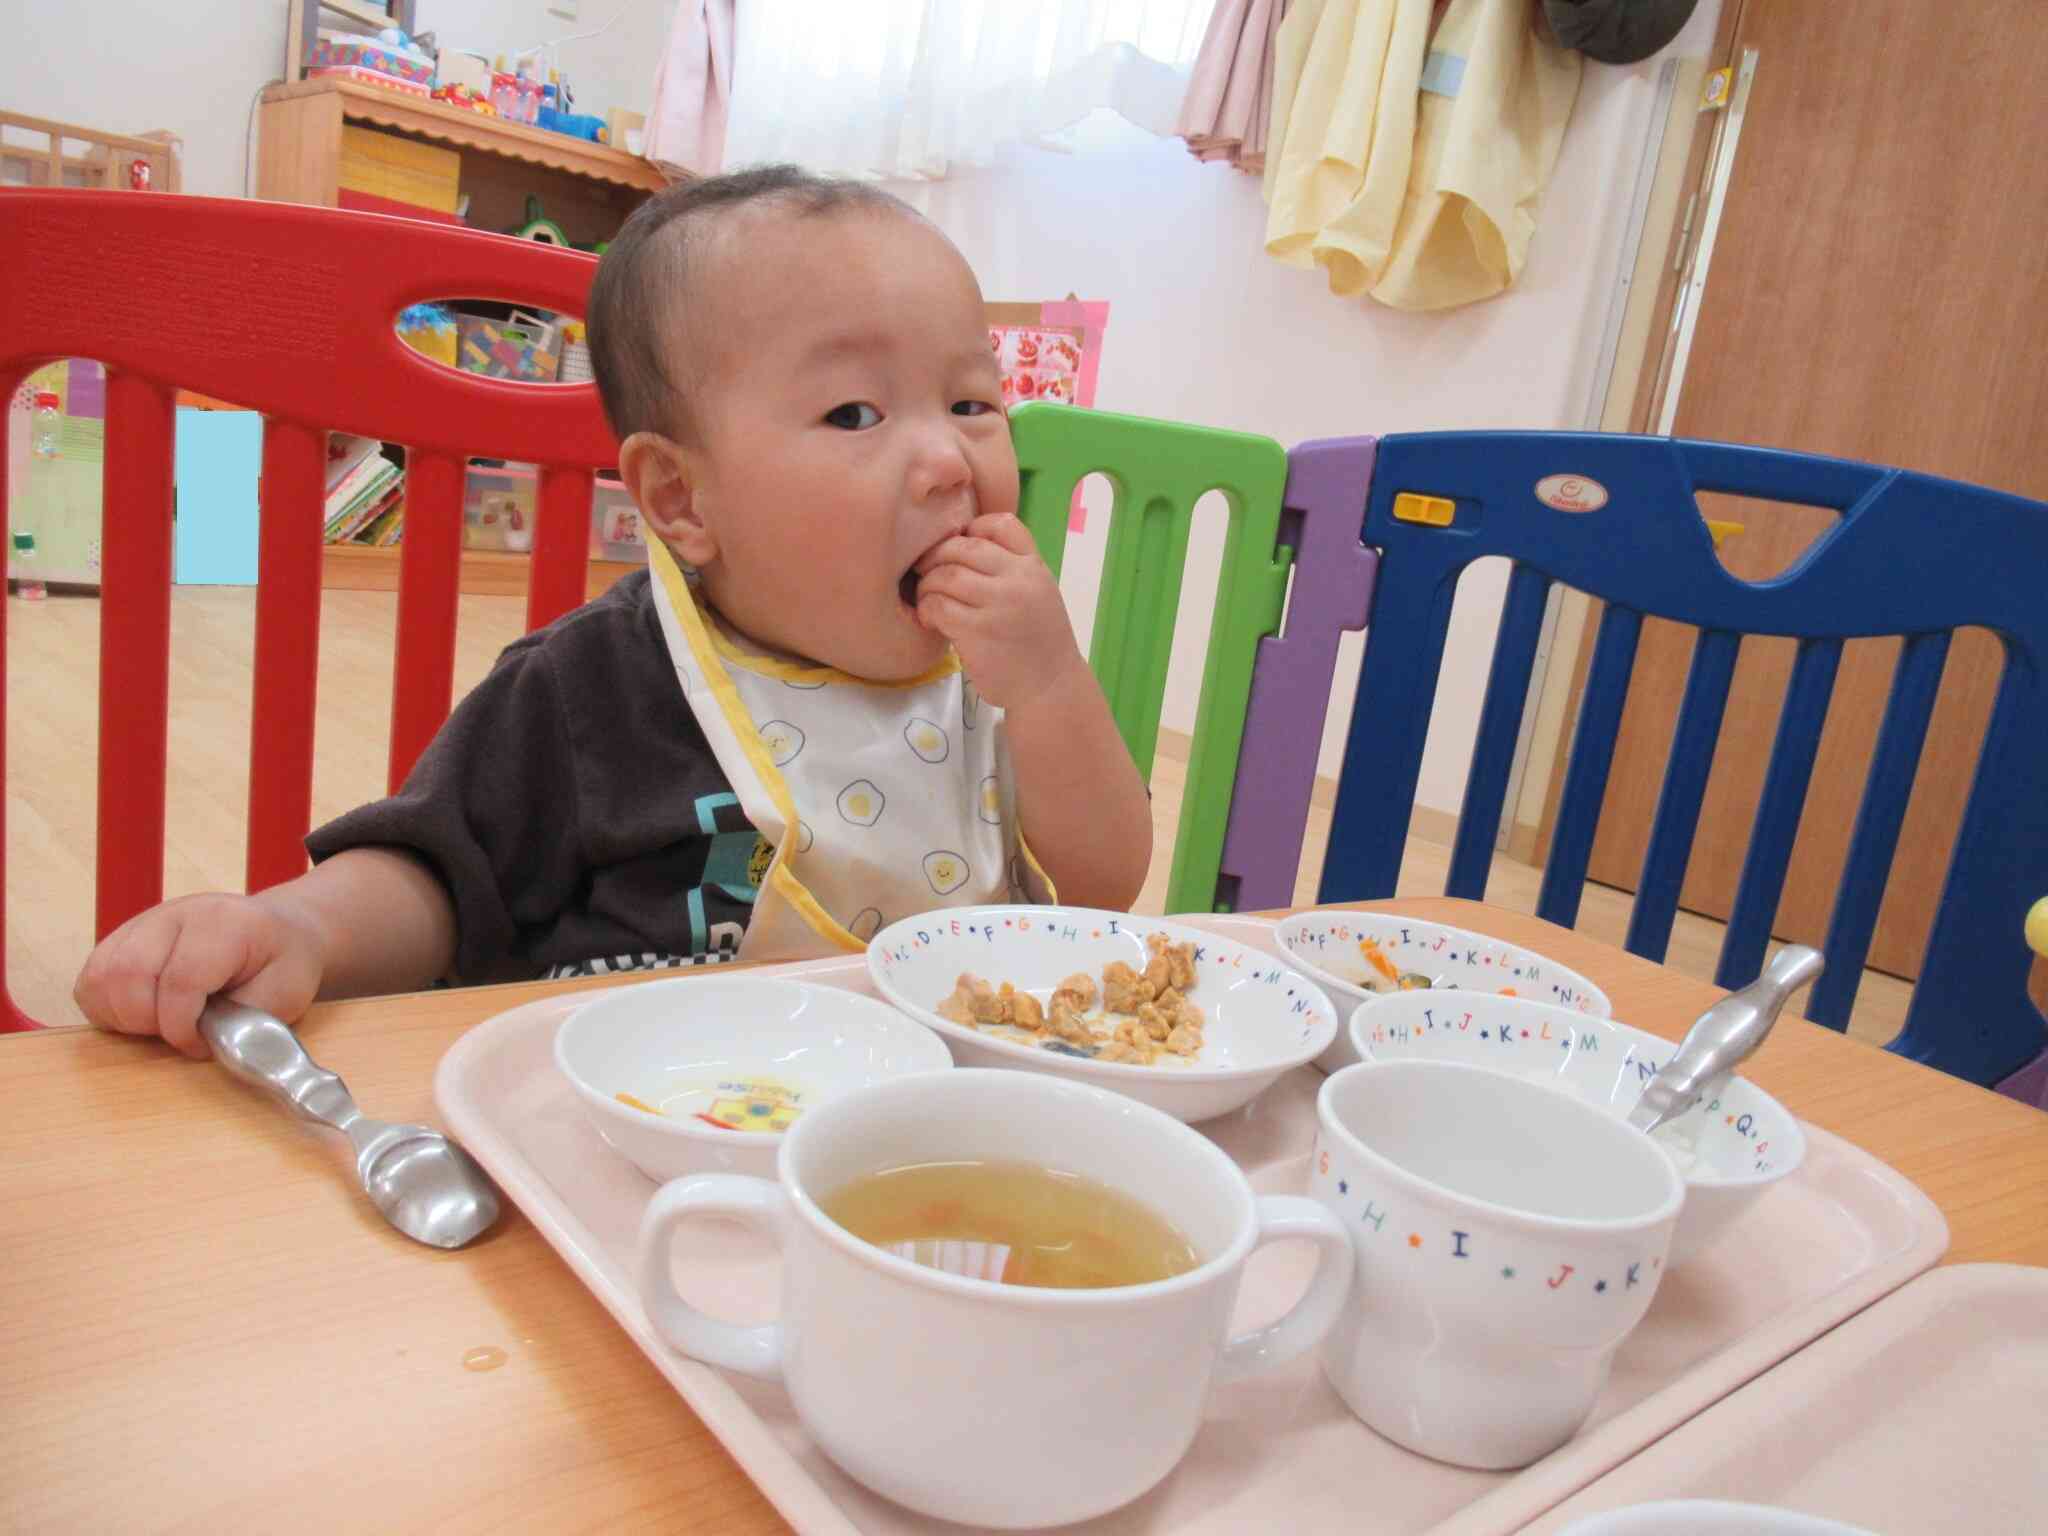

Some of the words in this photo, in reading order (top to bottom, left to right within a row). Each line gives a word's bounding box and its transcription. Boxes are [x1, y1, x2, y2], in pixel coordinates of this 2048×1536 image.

[917, 931, 930, 944] D
[951, 920, 960, 936] E
[984, 926, 993, 942] F
[1109, 920, 1119, 934] I
[1194, 947, 1206, 961] K
[1401, 929, 1411, 944] I
[1432, 937, 1447, 951] J
[1466, 951, 1477, 965] K
[1499, 954, 1509, 968] L
[1527, 967, 1540, 981] M
[1560, 988, 1573, 1002] N
[1424, 1009, 1433, 1029] I
[1458, 1012, 1472, 1030] J
[1500, 1025, 1513, 1042] K
[1541, 1022, 1552, 1040] L
[1579, 1034, 1599, 1051] M
[1638, 1061, 1657, 1080] N
[1737, 1114, 1753, 1136] Q
[1361, 1200, 1385, 1232] H
[1452, 1231, 1469, 1258] I
[1547, 1264, 1575, 1288] J
[1626, 1262, 1641, 1290] K
